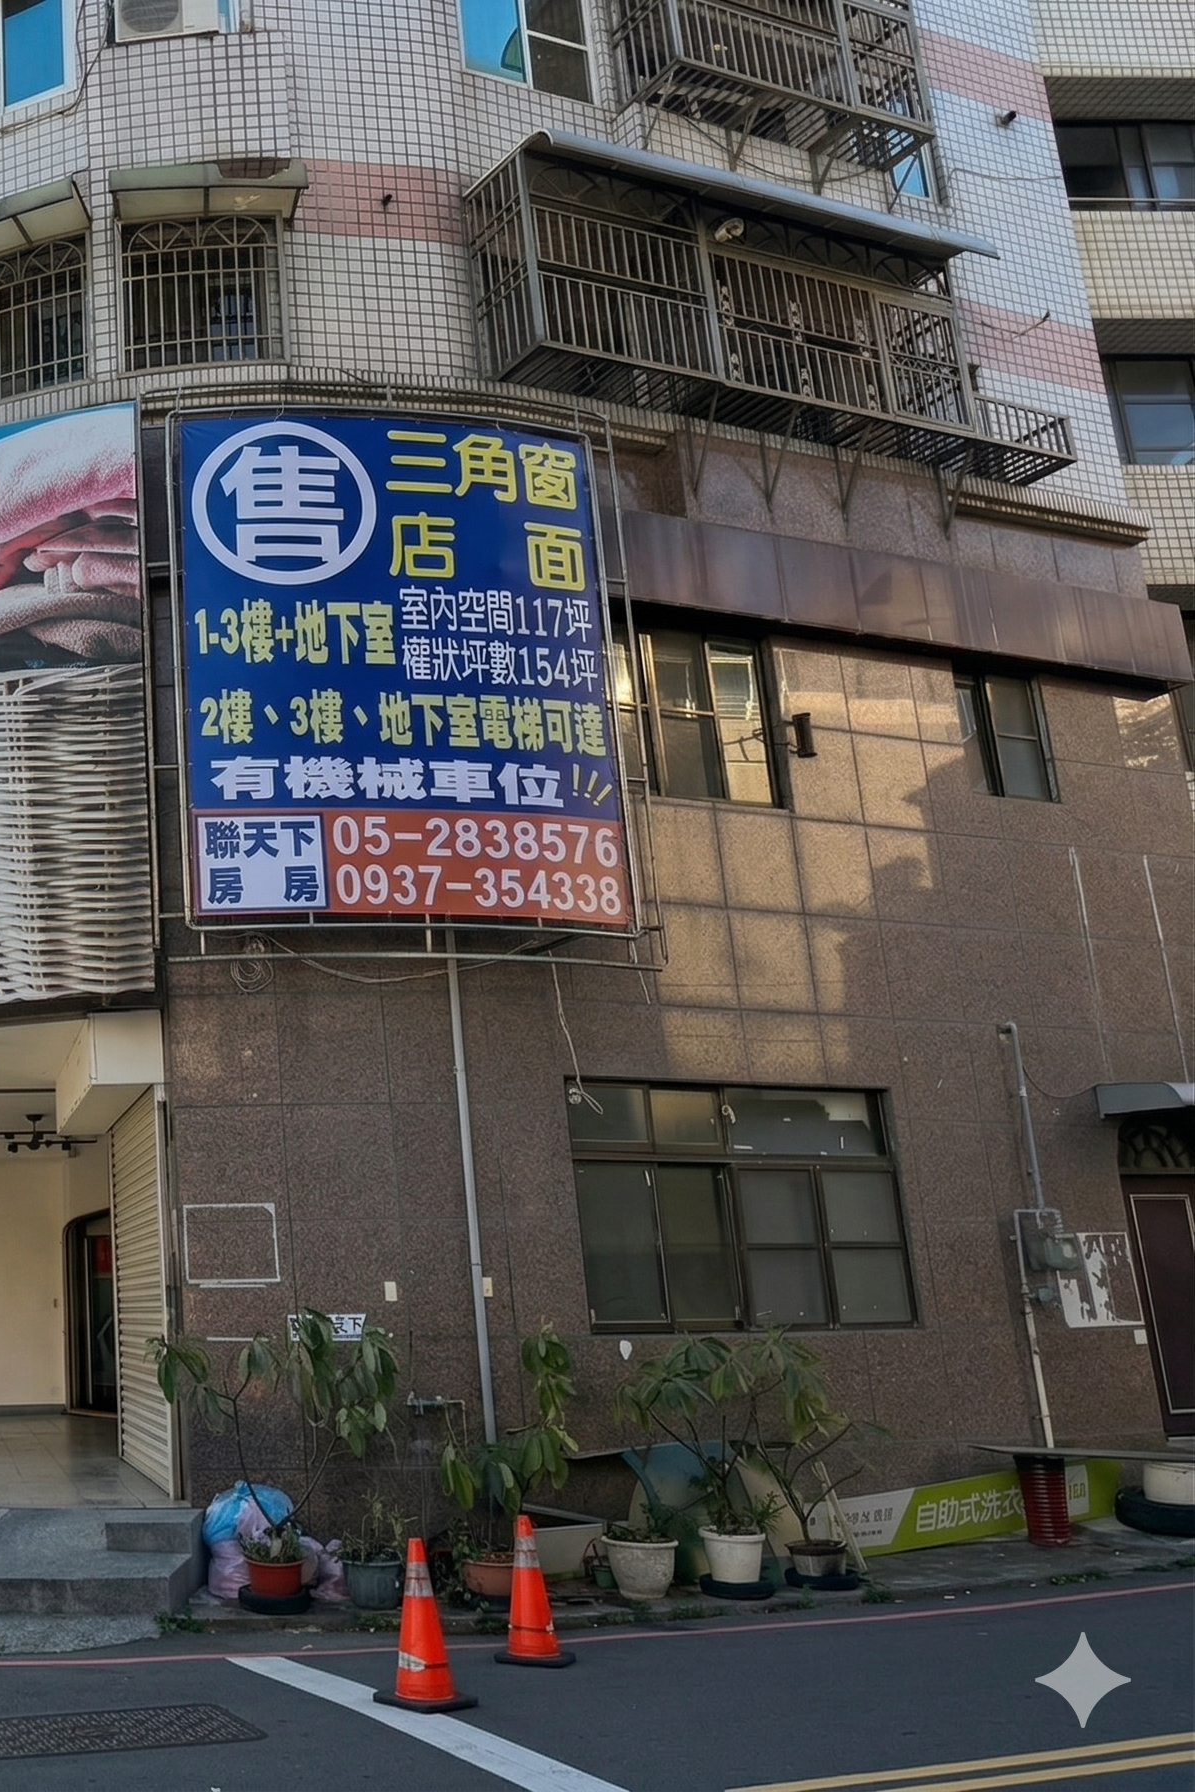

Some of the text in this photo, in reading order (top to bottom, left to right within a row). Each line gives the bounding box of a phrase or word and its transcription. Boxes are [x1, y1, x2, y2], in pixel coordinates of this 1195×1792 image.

[386, 430, 578, 510] 三角窗
[220, 445, 344, 562] 售
[194, 598, 396, 665] 1-3樓+地下室
[399, 585, 593, 643] 室內空間117坪
[402, 636, 598, 692] 權狀坪數154坪
[205, 820, 316, 860] 聯天下
[333, 815, 618, 868] 05-2838576
[335, 863, 621, 917] 0937-354338
[916, 1485, 1025, 1533] 自助式洗衣
